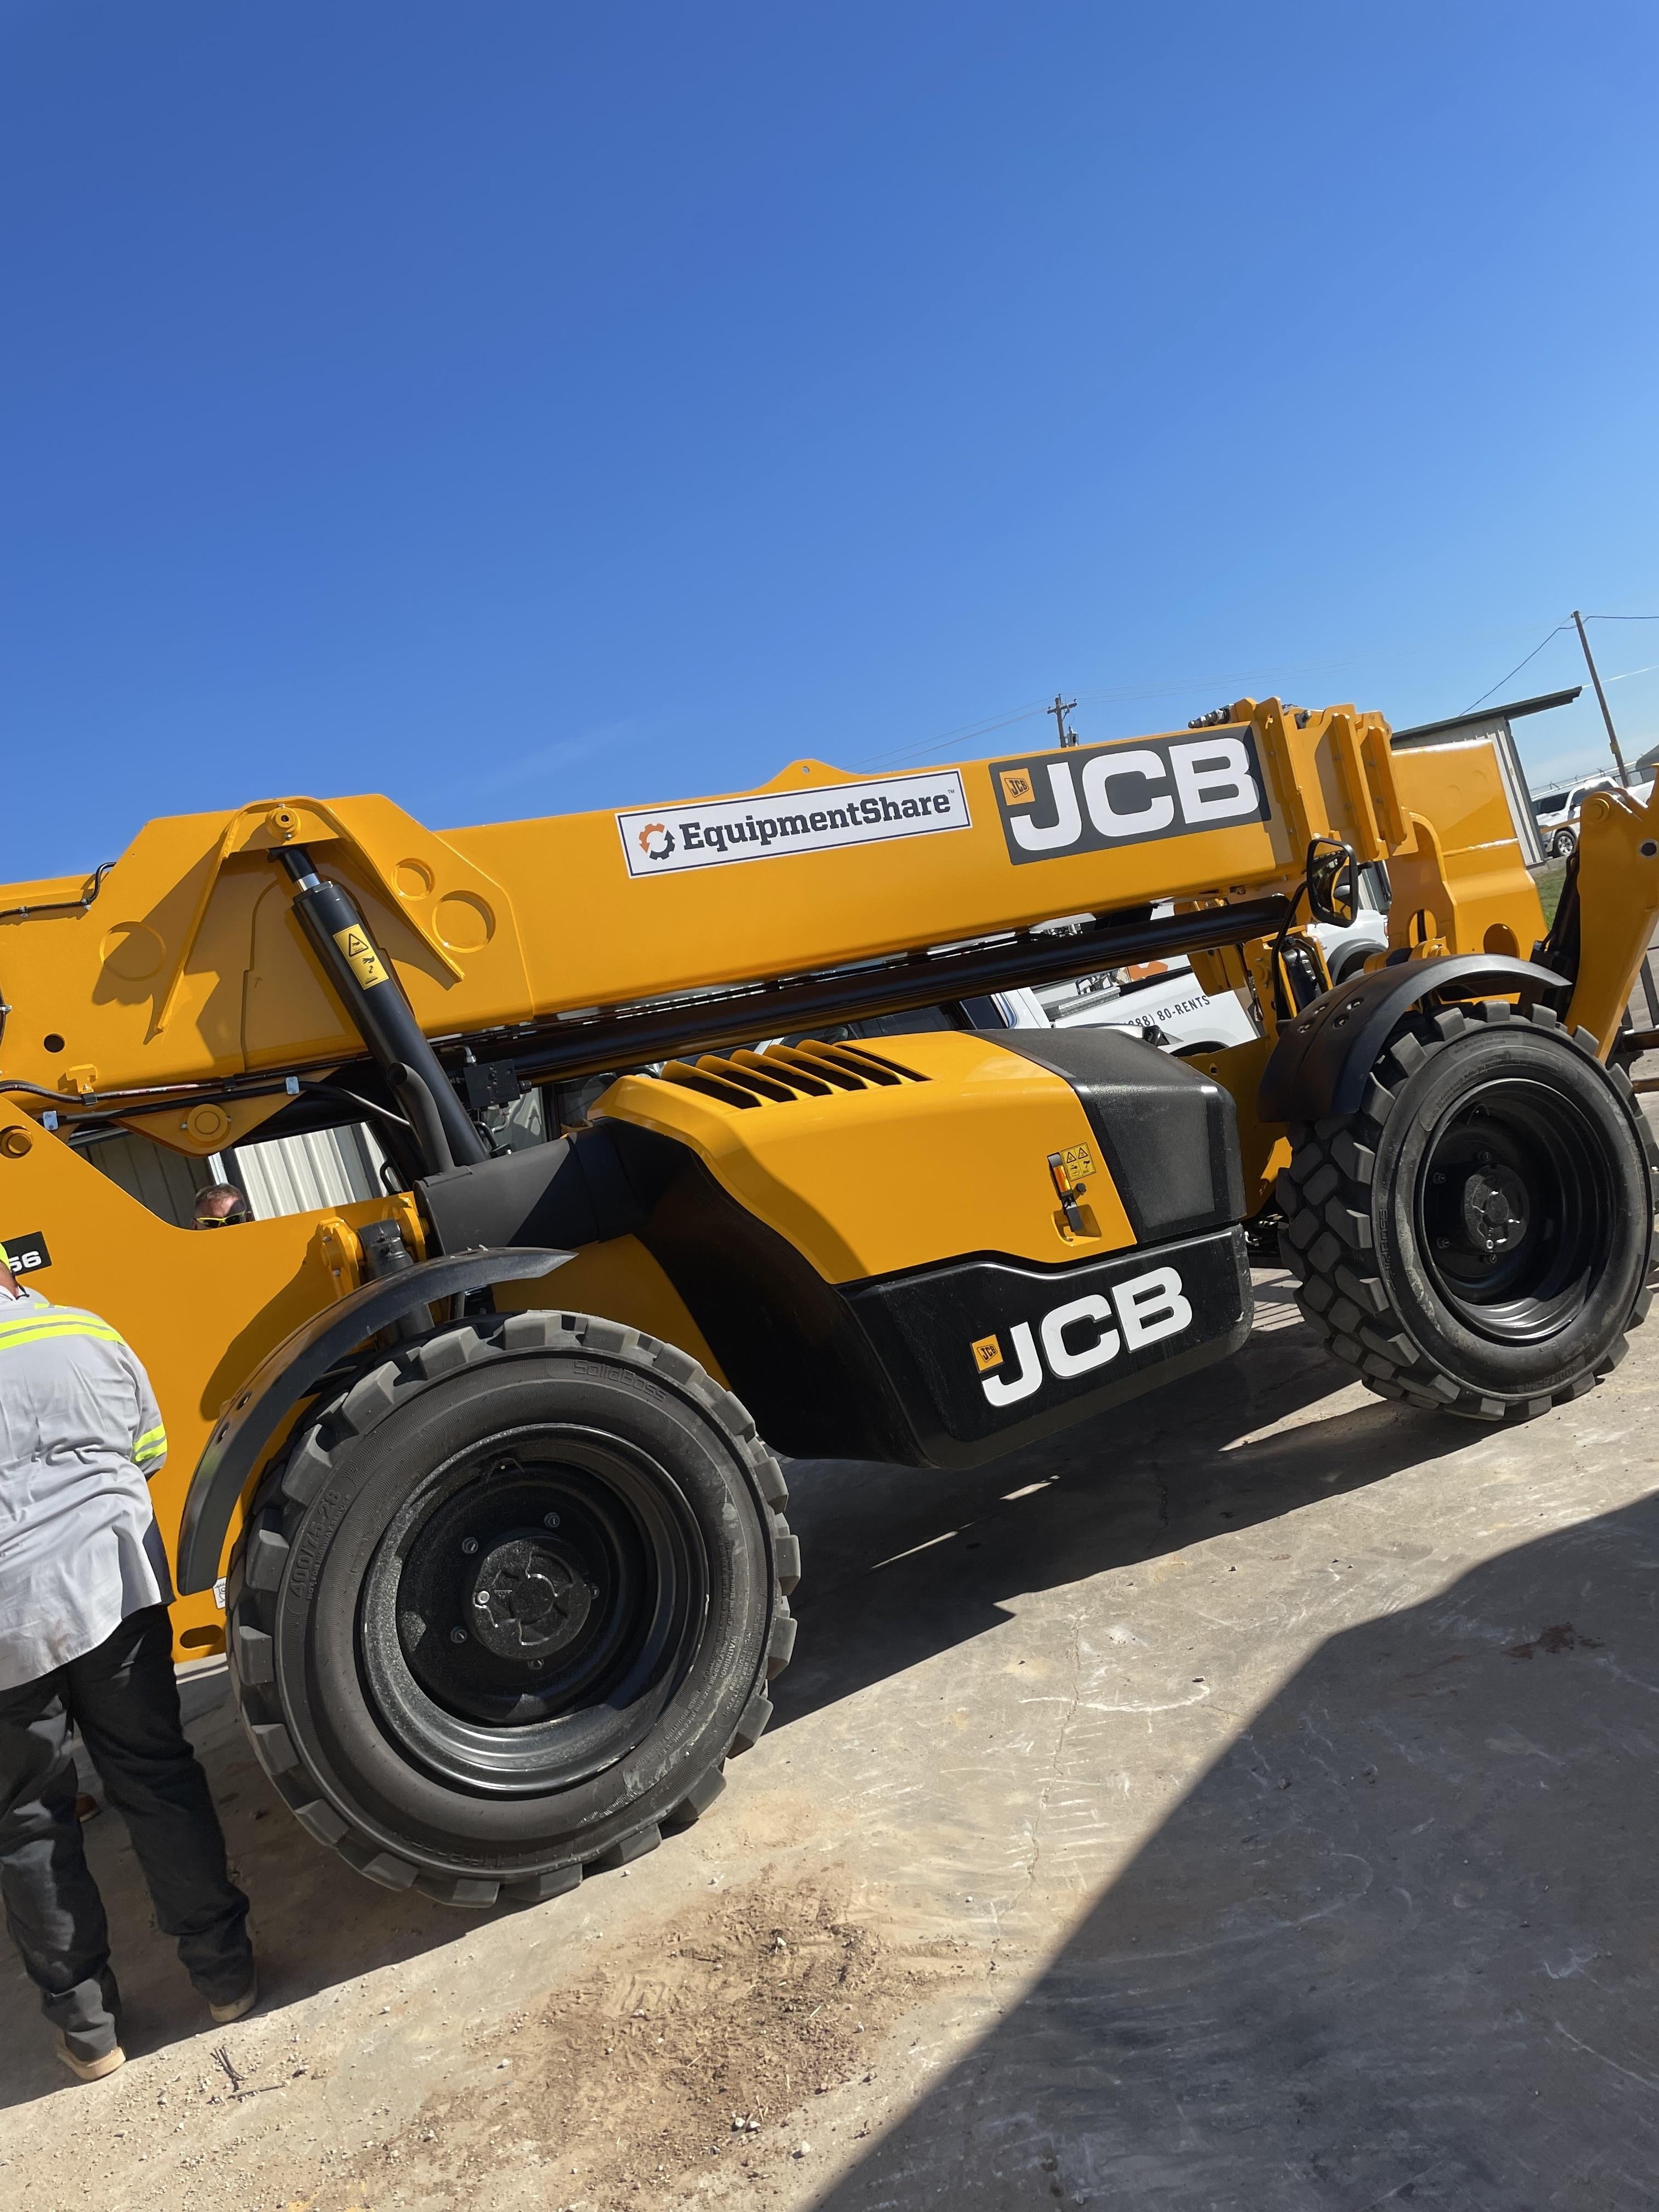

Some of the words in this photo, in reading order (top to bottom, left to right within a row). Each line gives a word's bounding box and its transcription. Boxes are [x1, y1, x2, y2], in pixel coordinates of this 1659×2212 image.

[1009, 778, 1029, 796] JCB
[1011, 737, 1260, 851] JCB
[679, 795, 950, 853] EquipmentShare
[1156, 995, 1210, 1021] 80-RENTS
[980, 1346, 996, 1361] JCB
[981, 1266, 1193, 1406] JCB
